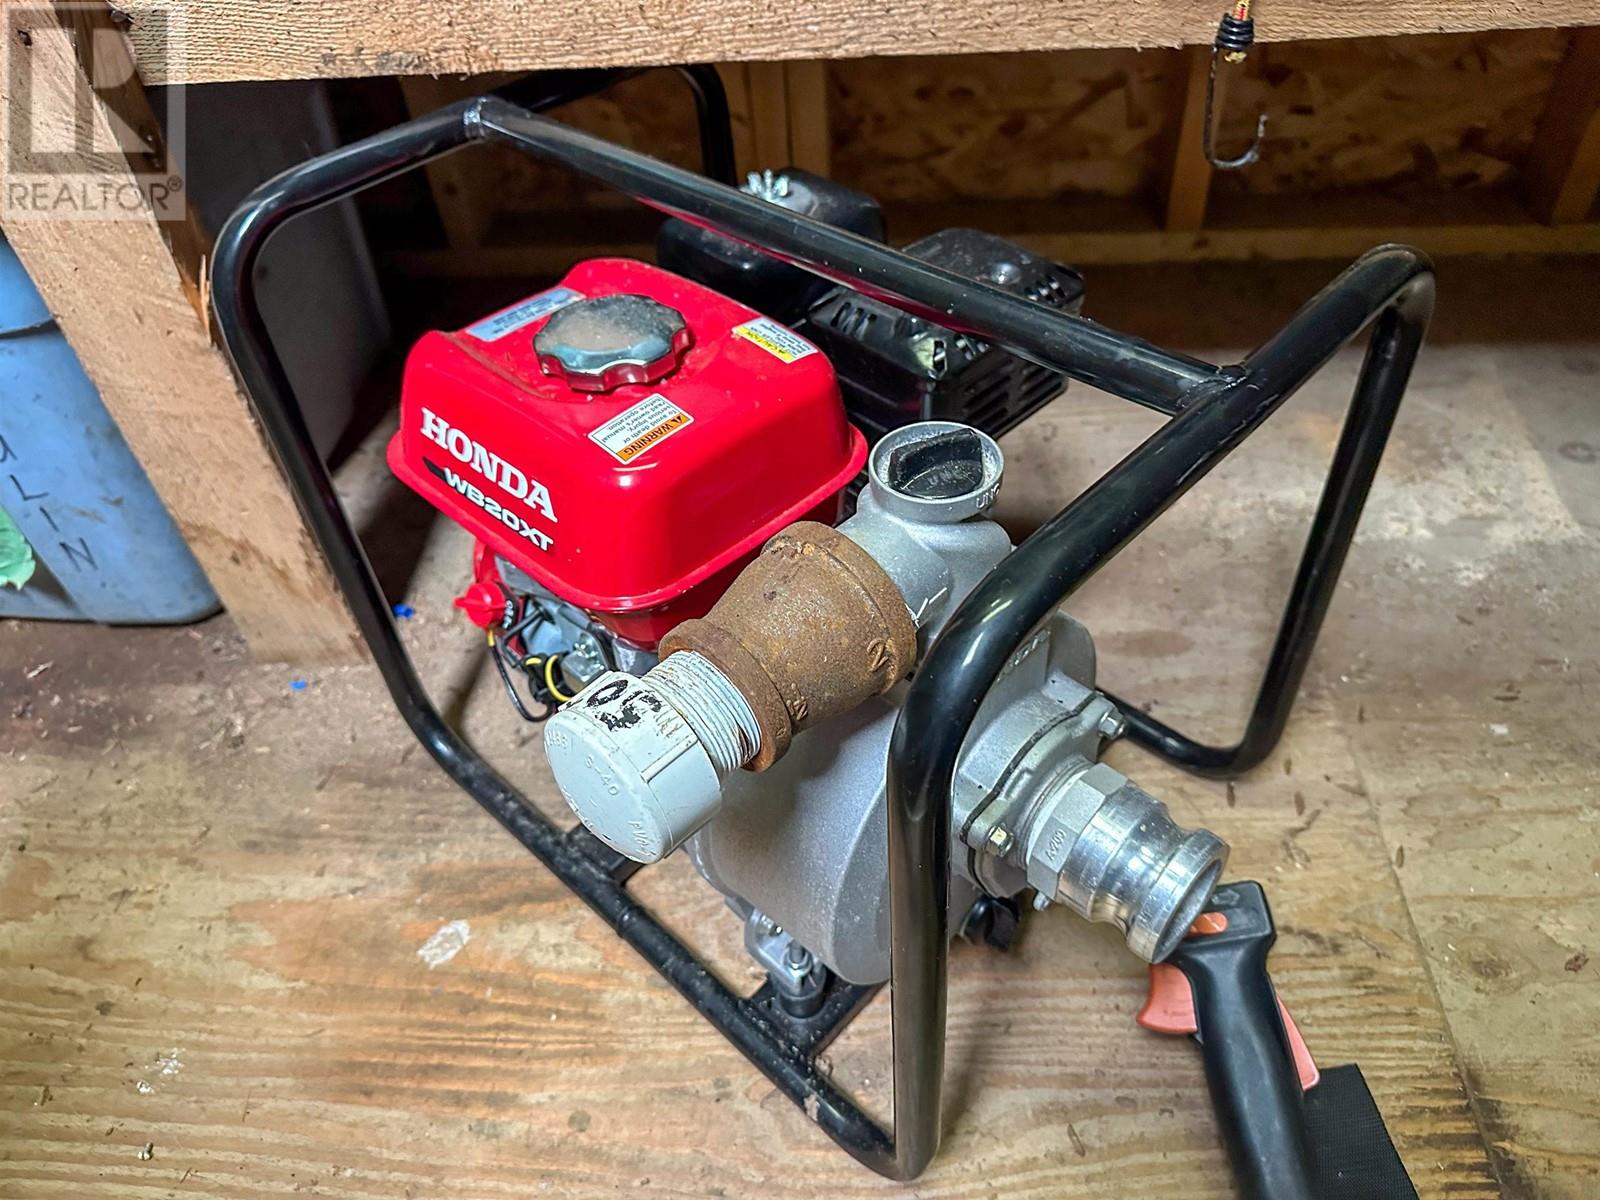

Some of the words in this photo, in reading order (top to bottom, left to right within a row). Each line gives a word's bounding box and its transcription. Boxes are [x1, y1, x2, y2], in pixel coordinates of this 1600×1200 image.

[420, 407, 558, 523] HONDA
[622, 422, 673, 455] WARNING
[443, 467, 554, 551] WB20XT
